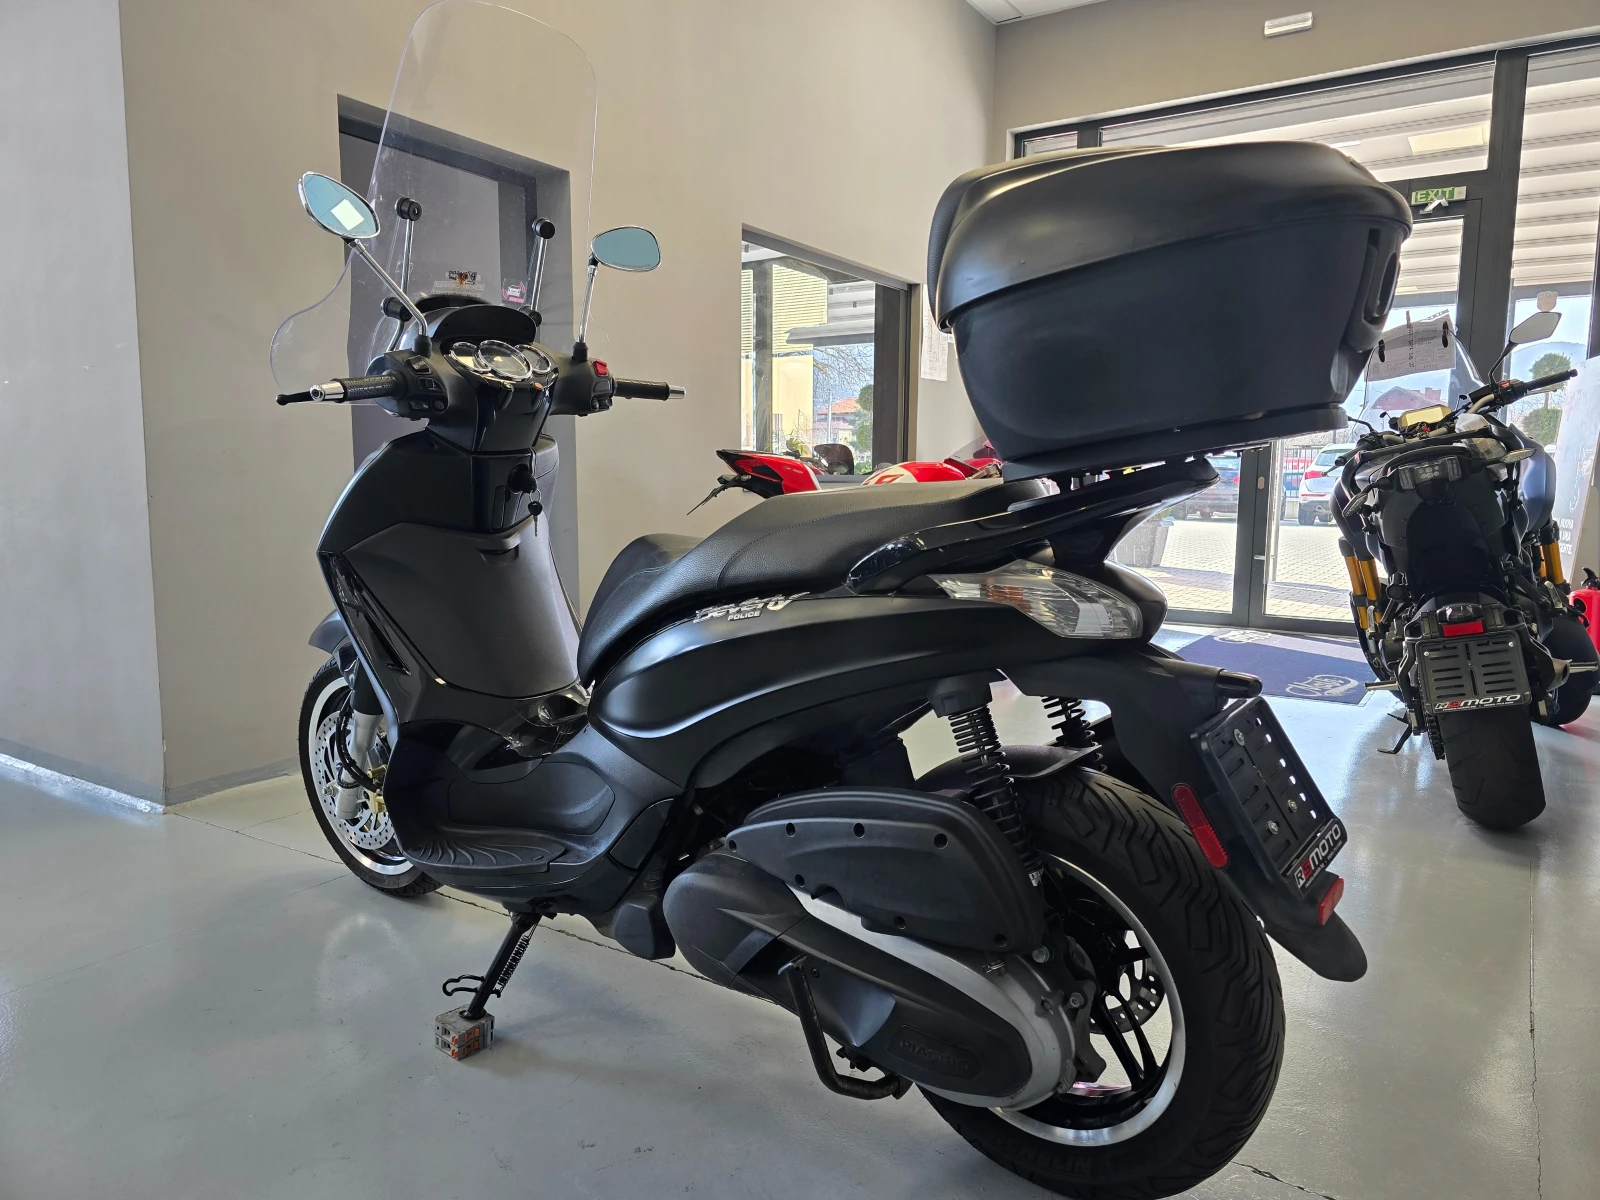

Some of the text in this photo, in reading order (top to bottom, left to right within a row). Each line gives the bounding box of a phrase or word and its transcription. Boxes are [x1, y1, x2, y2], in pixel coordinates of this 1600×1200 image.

[1416, 188, 1453, 203] EXIT
[728, 611, 761, 620] POLICE
[1294, 824, 1341, 888] RSMOTO
[900, 1040, 970, 1070] PIAGGIO
